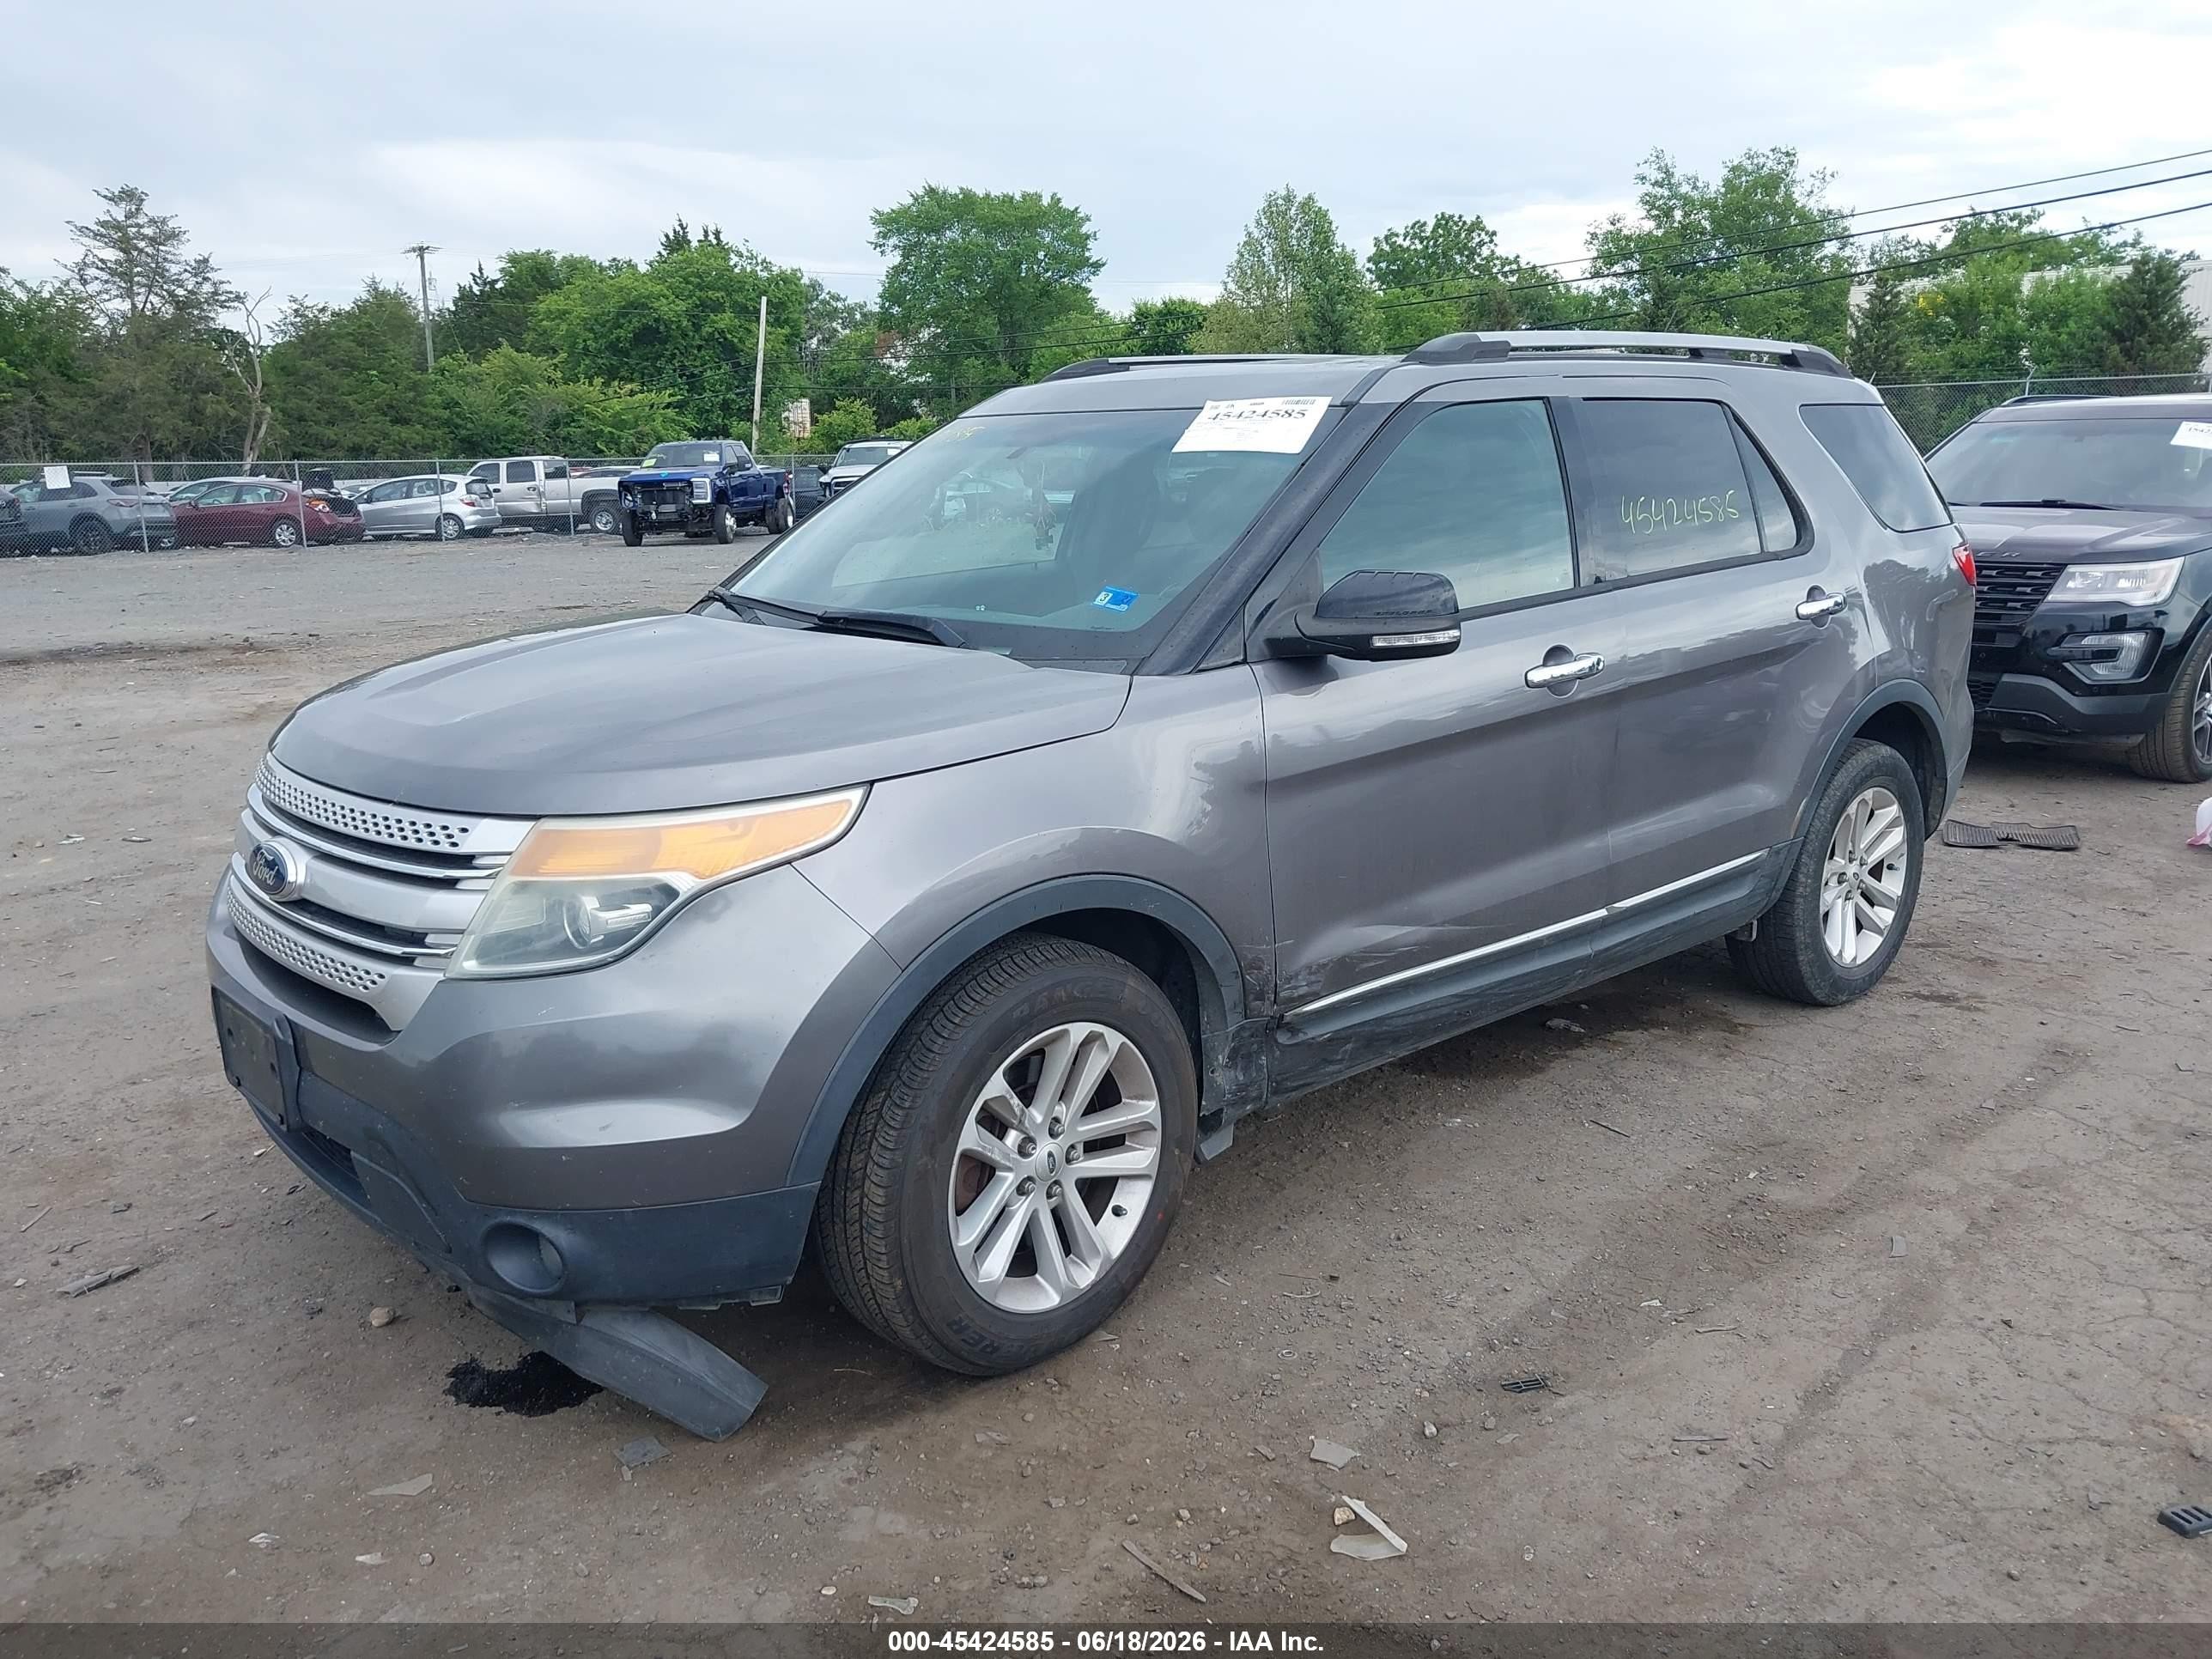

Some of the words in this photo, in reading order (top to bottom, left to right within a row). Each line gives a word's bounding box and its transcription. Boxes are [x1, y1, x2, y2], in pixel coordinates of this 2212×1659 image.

[1207, 410, 1308, 422] 45424585
[1620, 489, 1740, 535] 45424585
[252, 848, 278, 886] Ford
